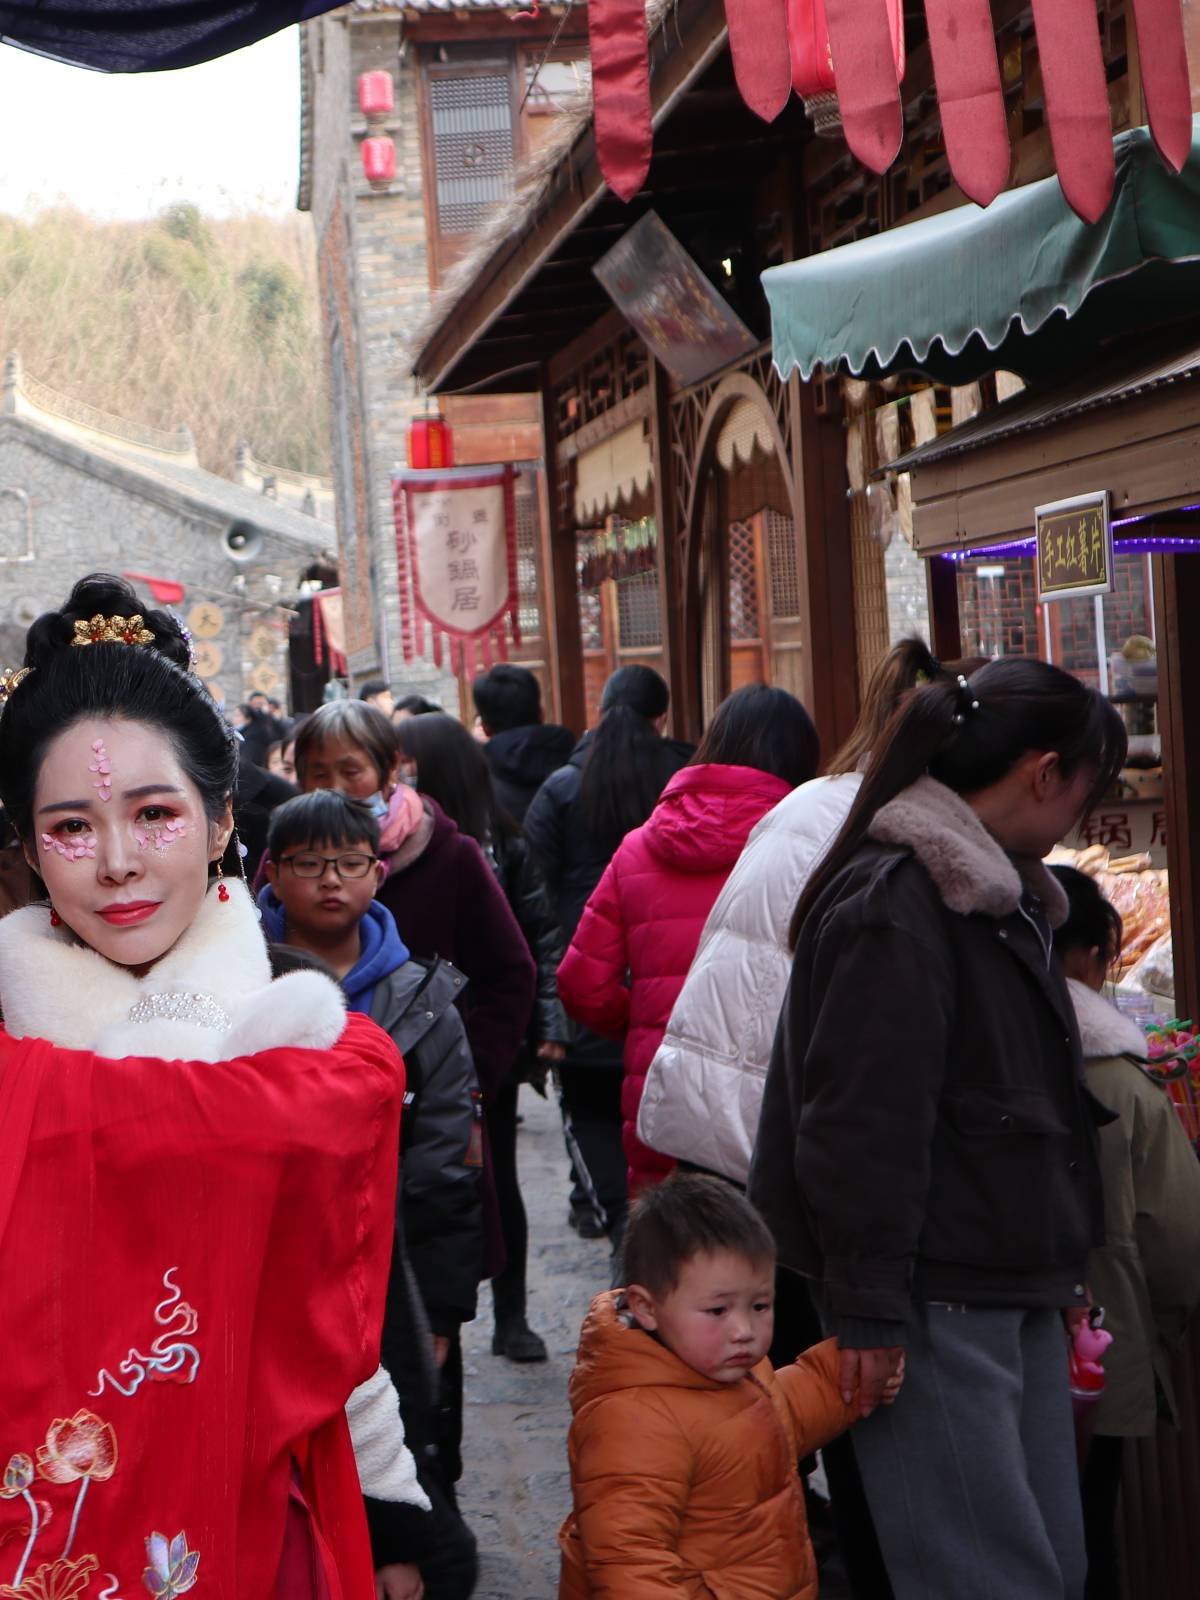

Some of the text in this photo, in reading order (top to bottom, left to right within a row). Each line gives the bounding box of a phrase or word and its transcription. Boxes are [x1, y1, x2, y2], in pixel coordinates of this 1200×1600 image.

[1044, 517, 1101, 579] 手工红薯片
